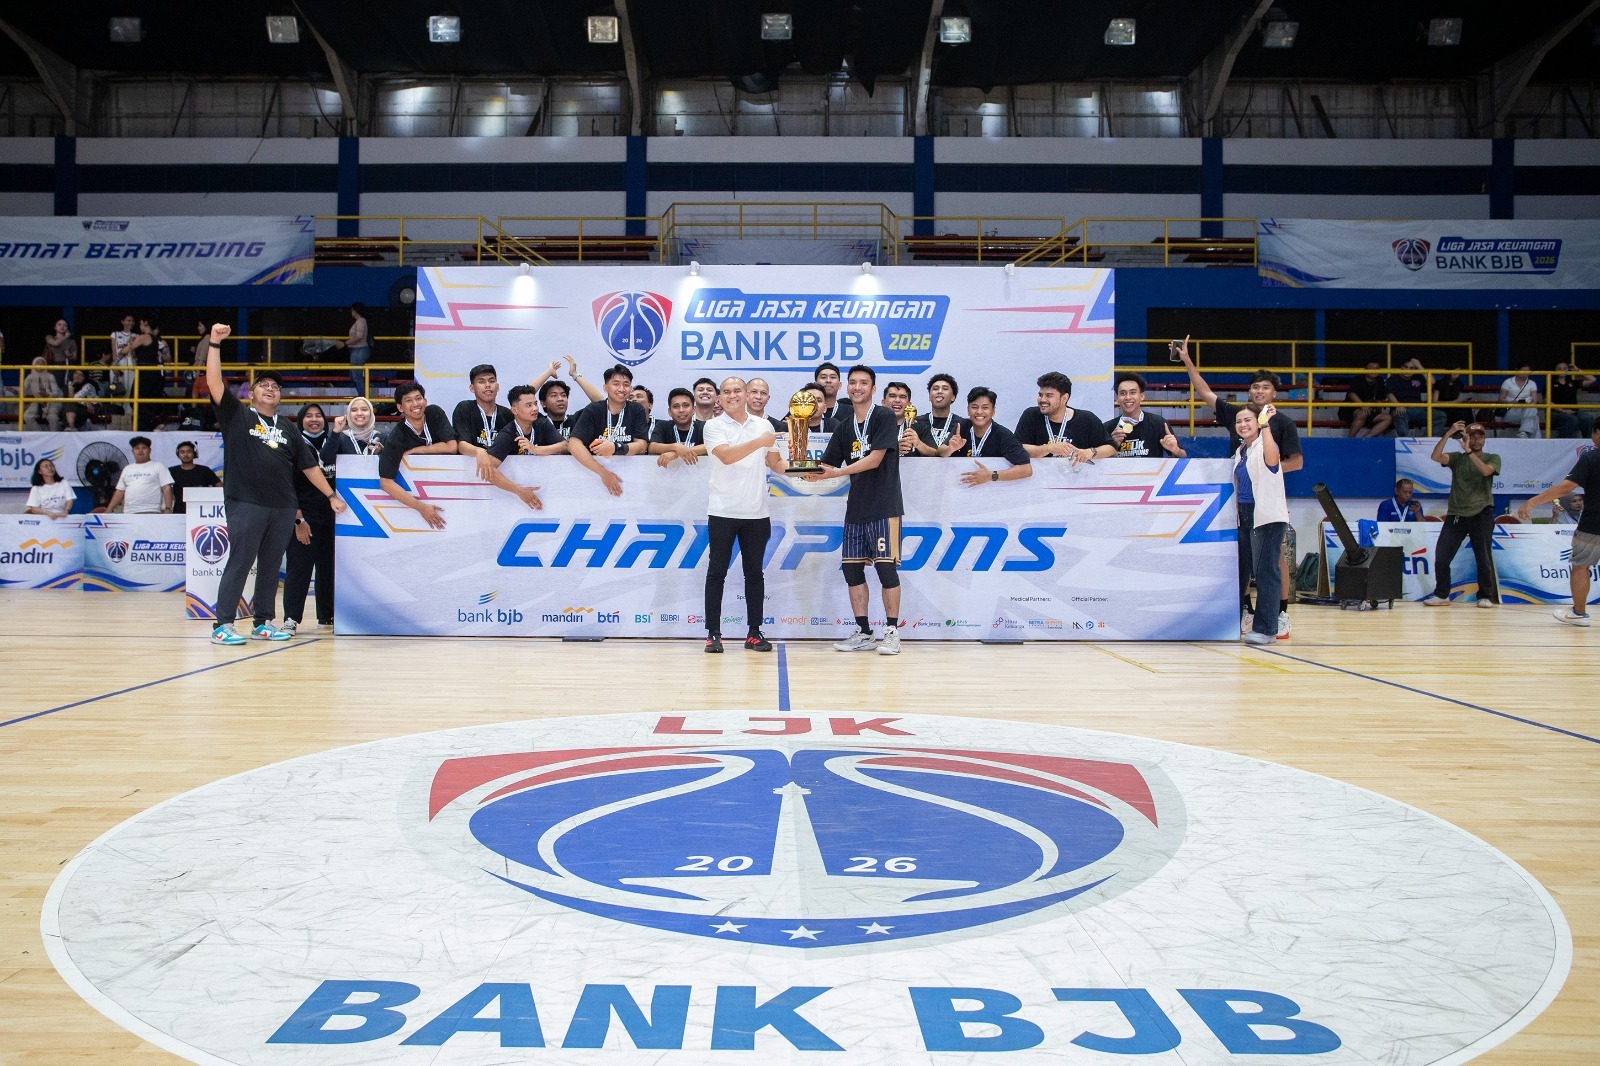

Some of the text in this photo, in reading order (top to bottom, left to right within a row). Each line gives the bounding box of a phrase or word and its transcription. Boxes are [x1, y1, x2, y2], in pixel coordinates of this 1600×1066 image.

[84, 241, 266, 259] BERTANDING
[1440, 241, 1556, 251] LIGA JASA KEUANGAN
[1435, 255, 1524, 269] BANK BJB
[693, 300, 937, 320] LIGA JASA KEUANGAN
[681, 330, 864, 361] BANK BJB
[888, 334, 932, 351] 2026
[0, 448, 35, 470] bjb
[200, 505, 224, 518] LJK
[496, 519, 1068, 572] CHAPONS
[877, 537, 886, 552] 6
[130, 552, 185, 562] BANK BJB
[1402, 548, 1429, 575] tn
[192, 568, 214, 577] bank
[457, 609, 523, 626] bank bjb
[541, 611, 583, 623] mandiri
[597, 611, 620, 624] btn
[634, 613, 651, 624] BSI
[668, 614, 680, 622] BRI
[761, 616, 775, 625] CA
[780, 616, 808, 624] wondr
[651, 716, 918, 736] LJK
[673, 854, 919, 874] 20 26
[264, 979, 1343, 1055] BANK BJB
